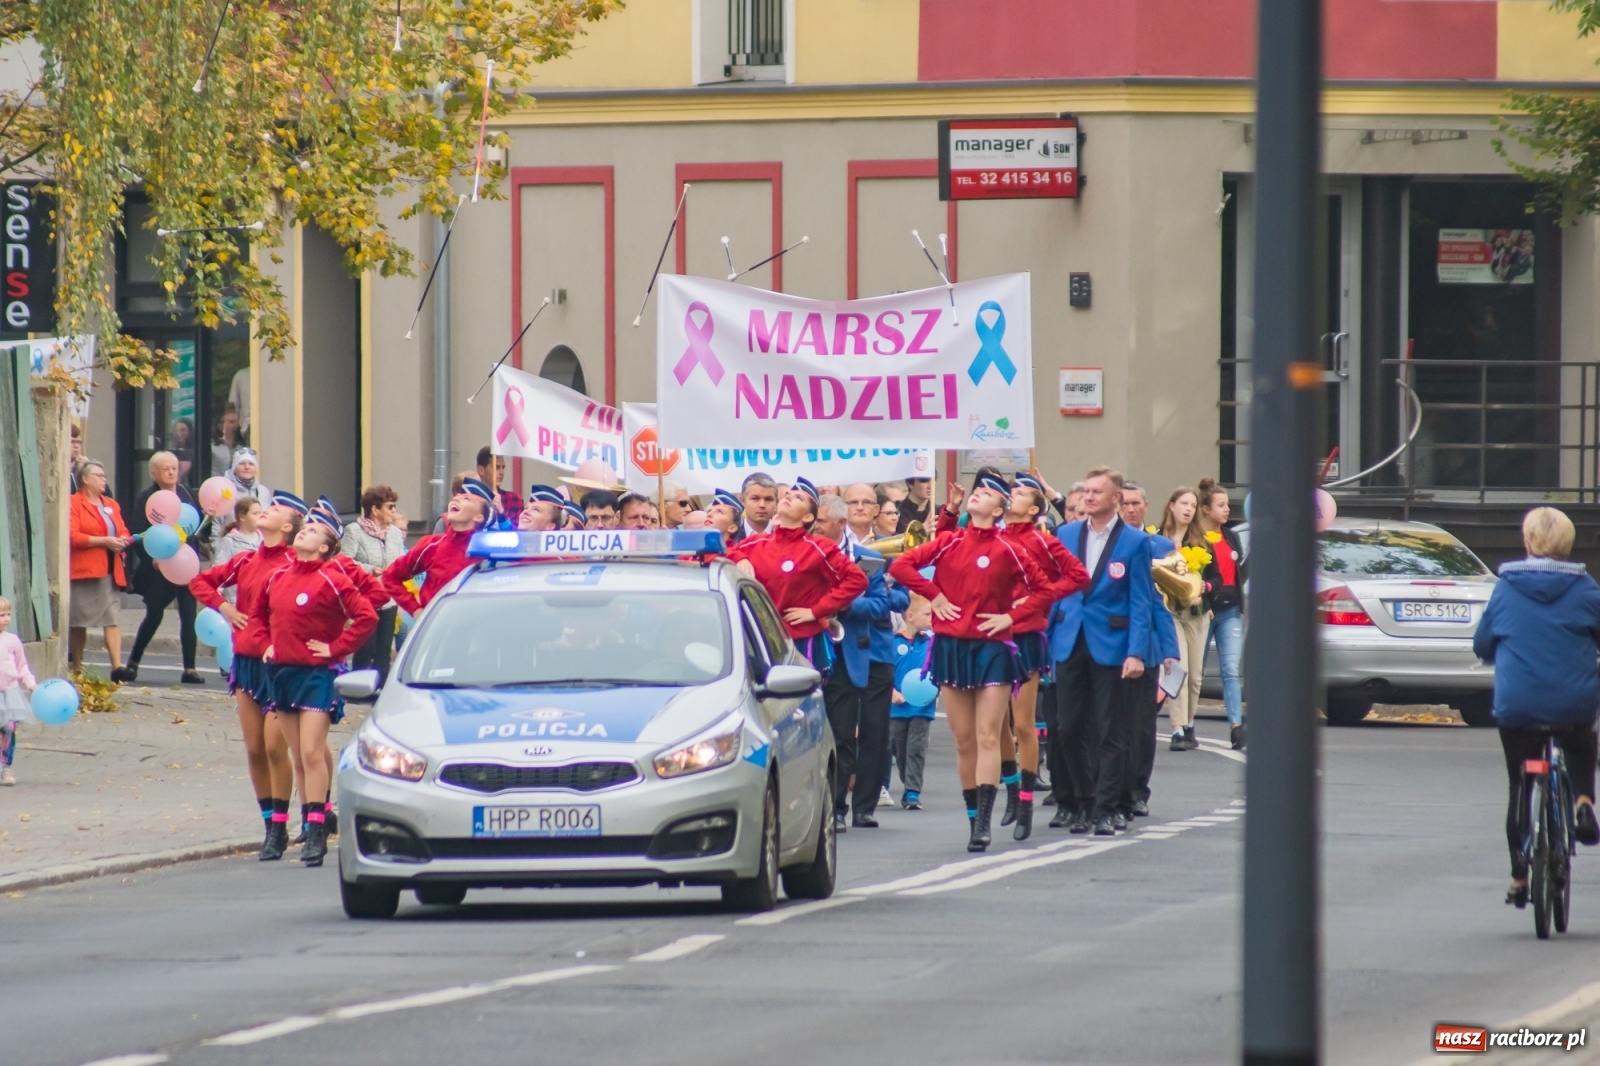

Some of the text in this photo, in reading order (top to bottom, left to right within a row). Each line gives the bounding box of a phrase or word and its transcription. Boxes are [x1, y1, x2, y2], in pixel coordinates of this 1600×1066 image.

[955, 138, 1035, 152] manager
[957, 171, 1073, 185] TEL. 32 415 34 16
[5, 184, 31, 327] sense
[748, 308, 943, 356] MARSZ
[735, 373, 959, 421] NADZIEI
[1064, 383, 1097, 393] manager
[538, 425, 618, 472] PRZED
[544, 534, 624, 552] POLICJA
[1404, 603, 1468, 617] SRC 51K2
[477, 722, 608, 740] POLICJA
[489, 808, 594, 831] HPP R006
